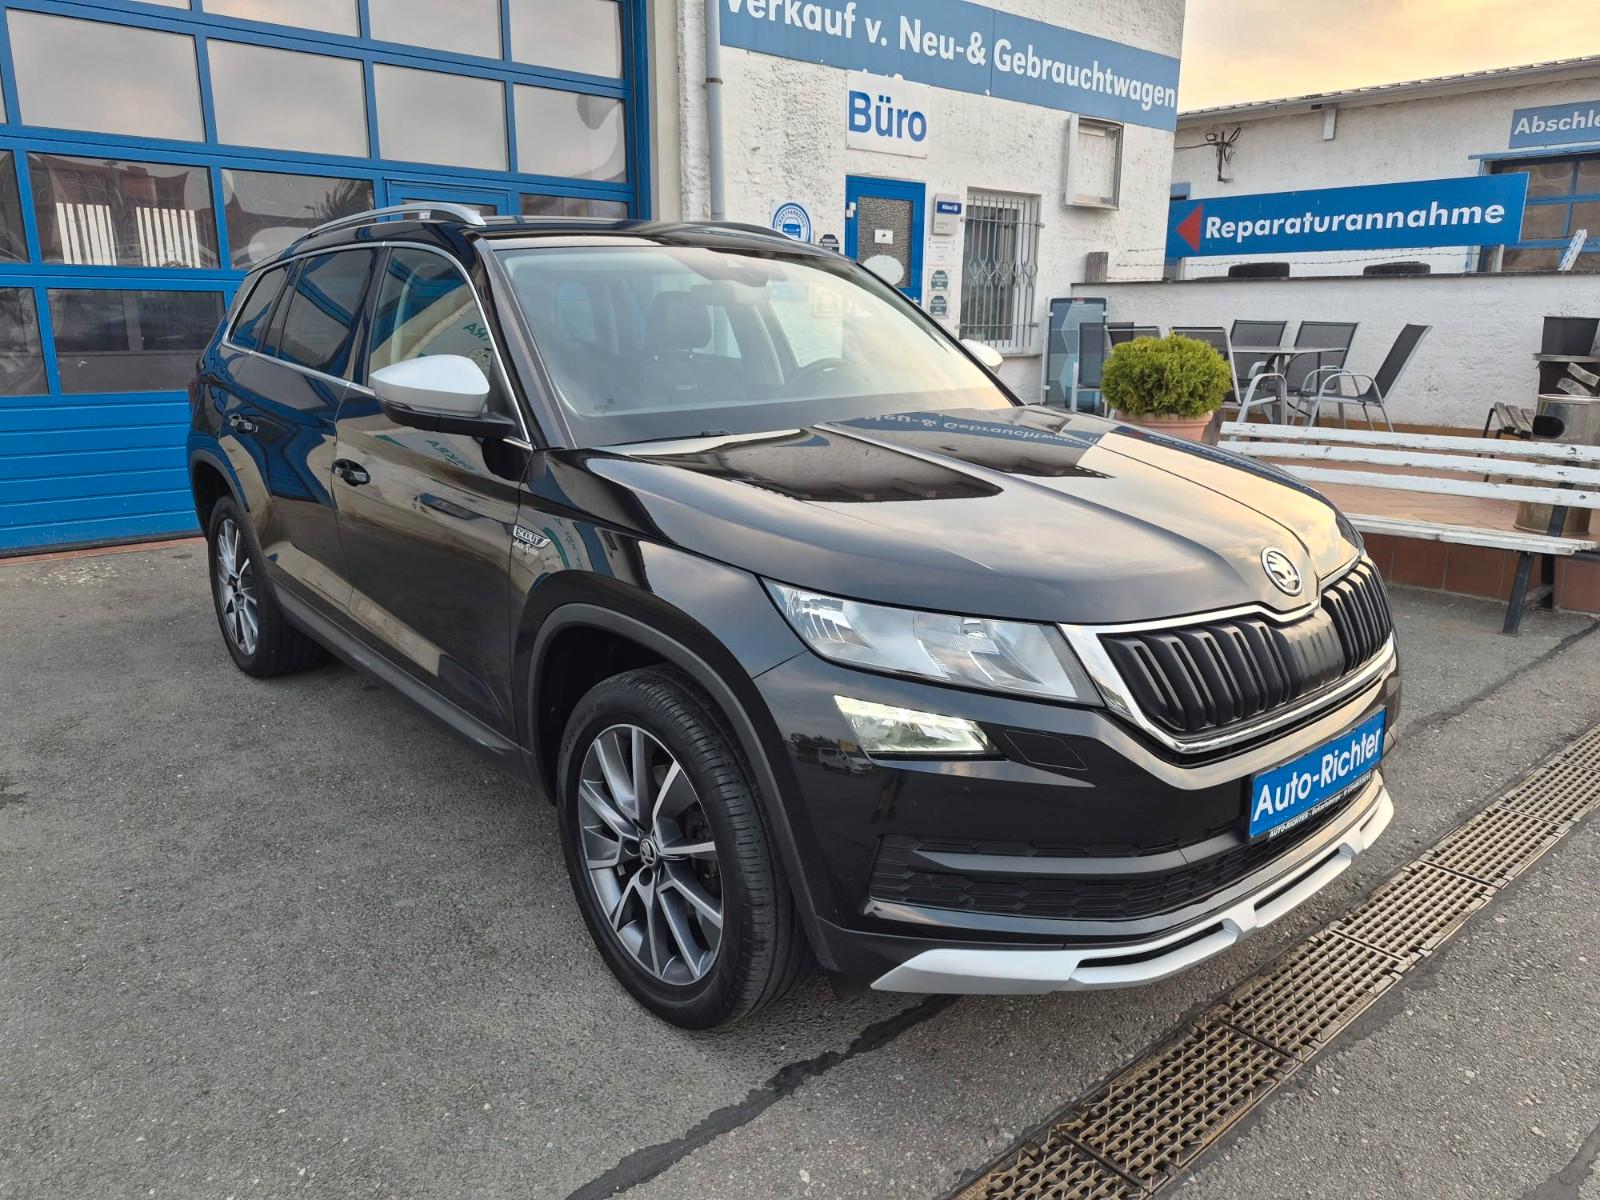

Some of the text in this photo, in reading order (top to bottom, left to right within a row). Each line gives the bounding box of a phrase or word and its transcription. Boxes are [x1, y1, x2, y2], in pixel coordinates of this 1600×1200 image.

[864, 18, 888, 46] v.
[994, 39, 1176, 111] Gebrauchtwagen
[849, 90, 927, 142] Büro
[1205, 202, 1505, 243] Reparaturannahme
[517, 527, 540, 545] SCOUT
[1253, 728, 1382, 822] Auto-Richter
